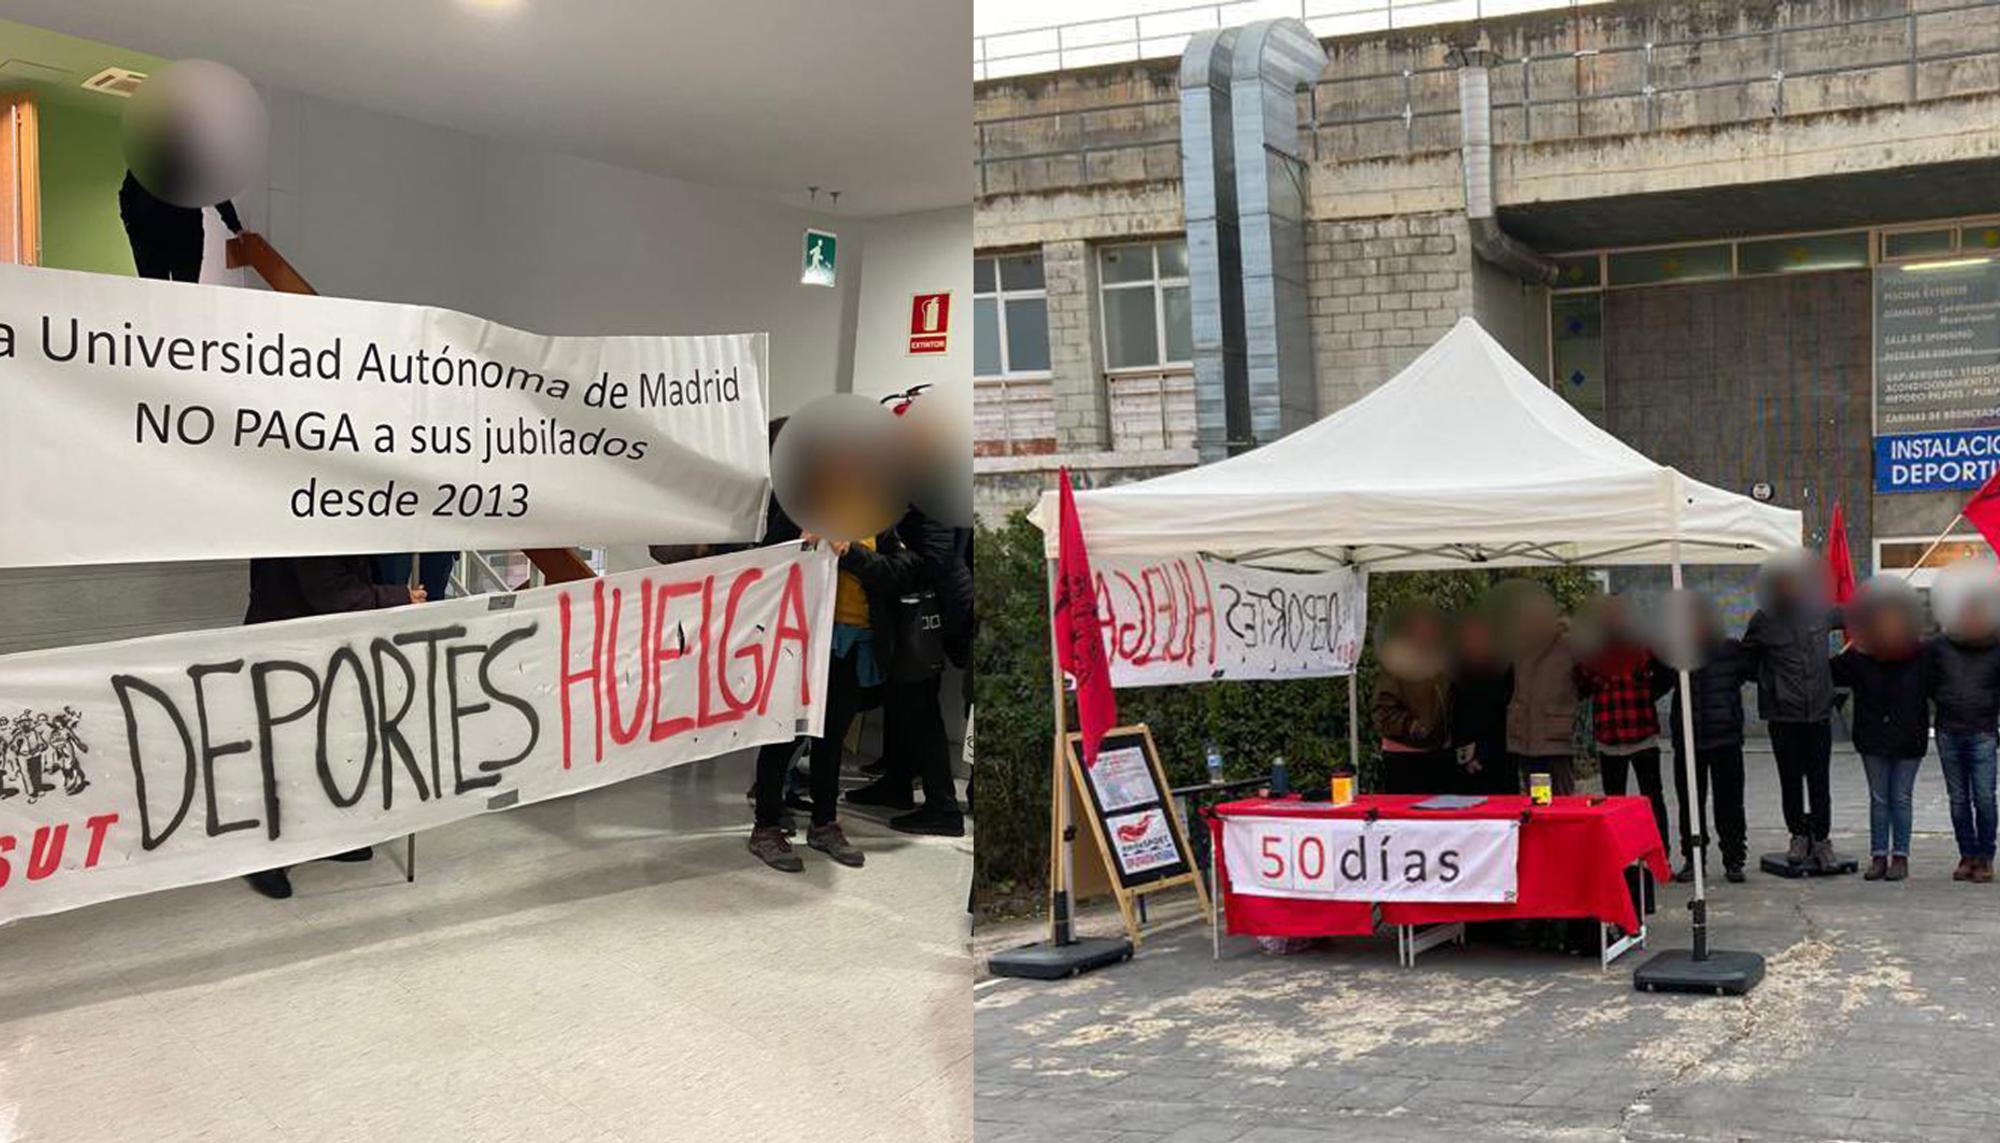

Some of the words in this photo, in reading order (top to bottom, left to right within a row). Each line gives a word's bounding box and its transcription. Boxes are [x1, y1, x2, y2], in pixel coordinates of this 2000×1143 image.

[42, 315, 341, 380] Universidad
[356, 342, 570, 400] Autónoma
[583, 371, 628, 410] de
[640, 366, 740, 408] Madrid
[136, 402, 215, 445] NO
[234, 408, 360, 452] PAGA
[374, 424, 394, 453] a
[410, 425, 471, 454] sus
[481, 416, 648, 464] jubilados
[291, 477, 419, 518] desde
[432, 483, 529, 518] 2013
[111, 622, 540, 850] DEPORTES
[557, 563, 813, 769] HUELGA
[1260, 835, 1325, 882] 50
[1340, 835, 1460, 883] días
